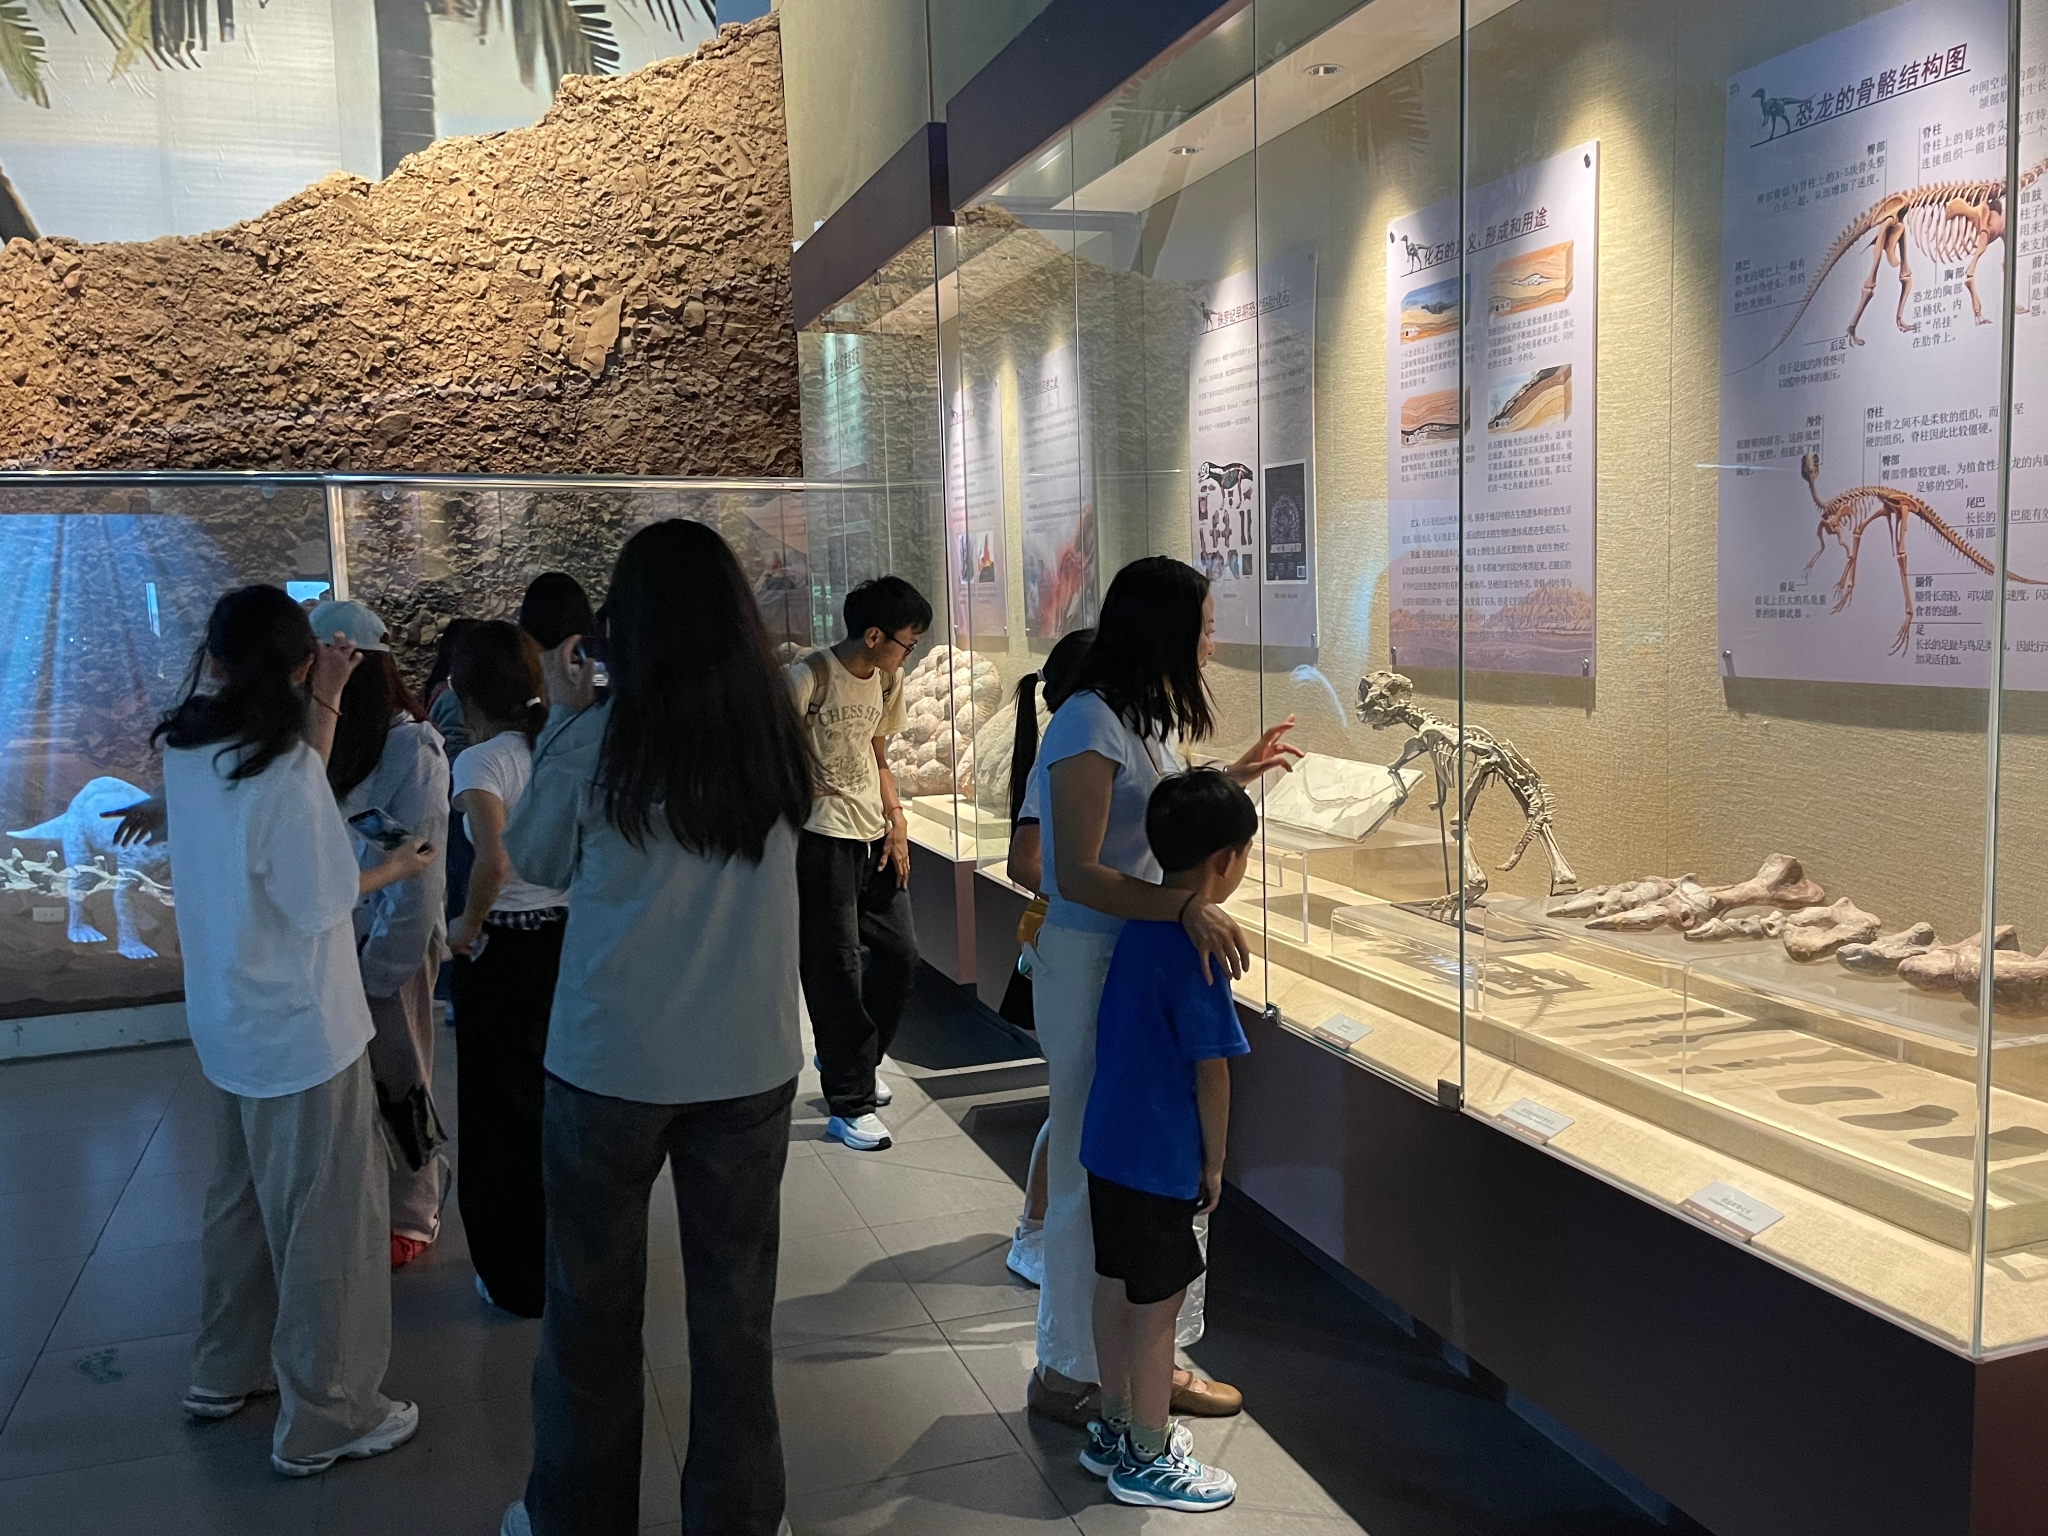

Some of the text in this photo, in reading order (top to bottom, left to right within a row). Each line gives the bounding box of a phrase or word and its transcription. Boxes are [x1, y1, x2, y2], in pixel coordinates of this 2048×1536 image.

[1795, 43, 1967, 127] 恐龙的骨骼结构图
[2020, 188, 2042, 205] 前肢
[1913, 283, 1962, 303] 恐龙的胸部
[1866, 402, 2024, 433] 脊柱骨之间不是柔软的组织，而坚
[1867, 406, 1884, 419] 脊柱
[1917, 478, 1969, 493] 足够的空间。
[1966, 496, 1985, 509] 尾巴
[1916, 624, 1925, 635] 足
[819, 705, 880, 726] CHESS SET
